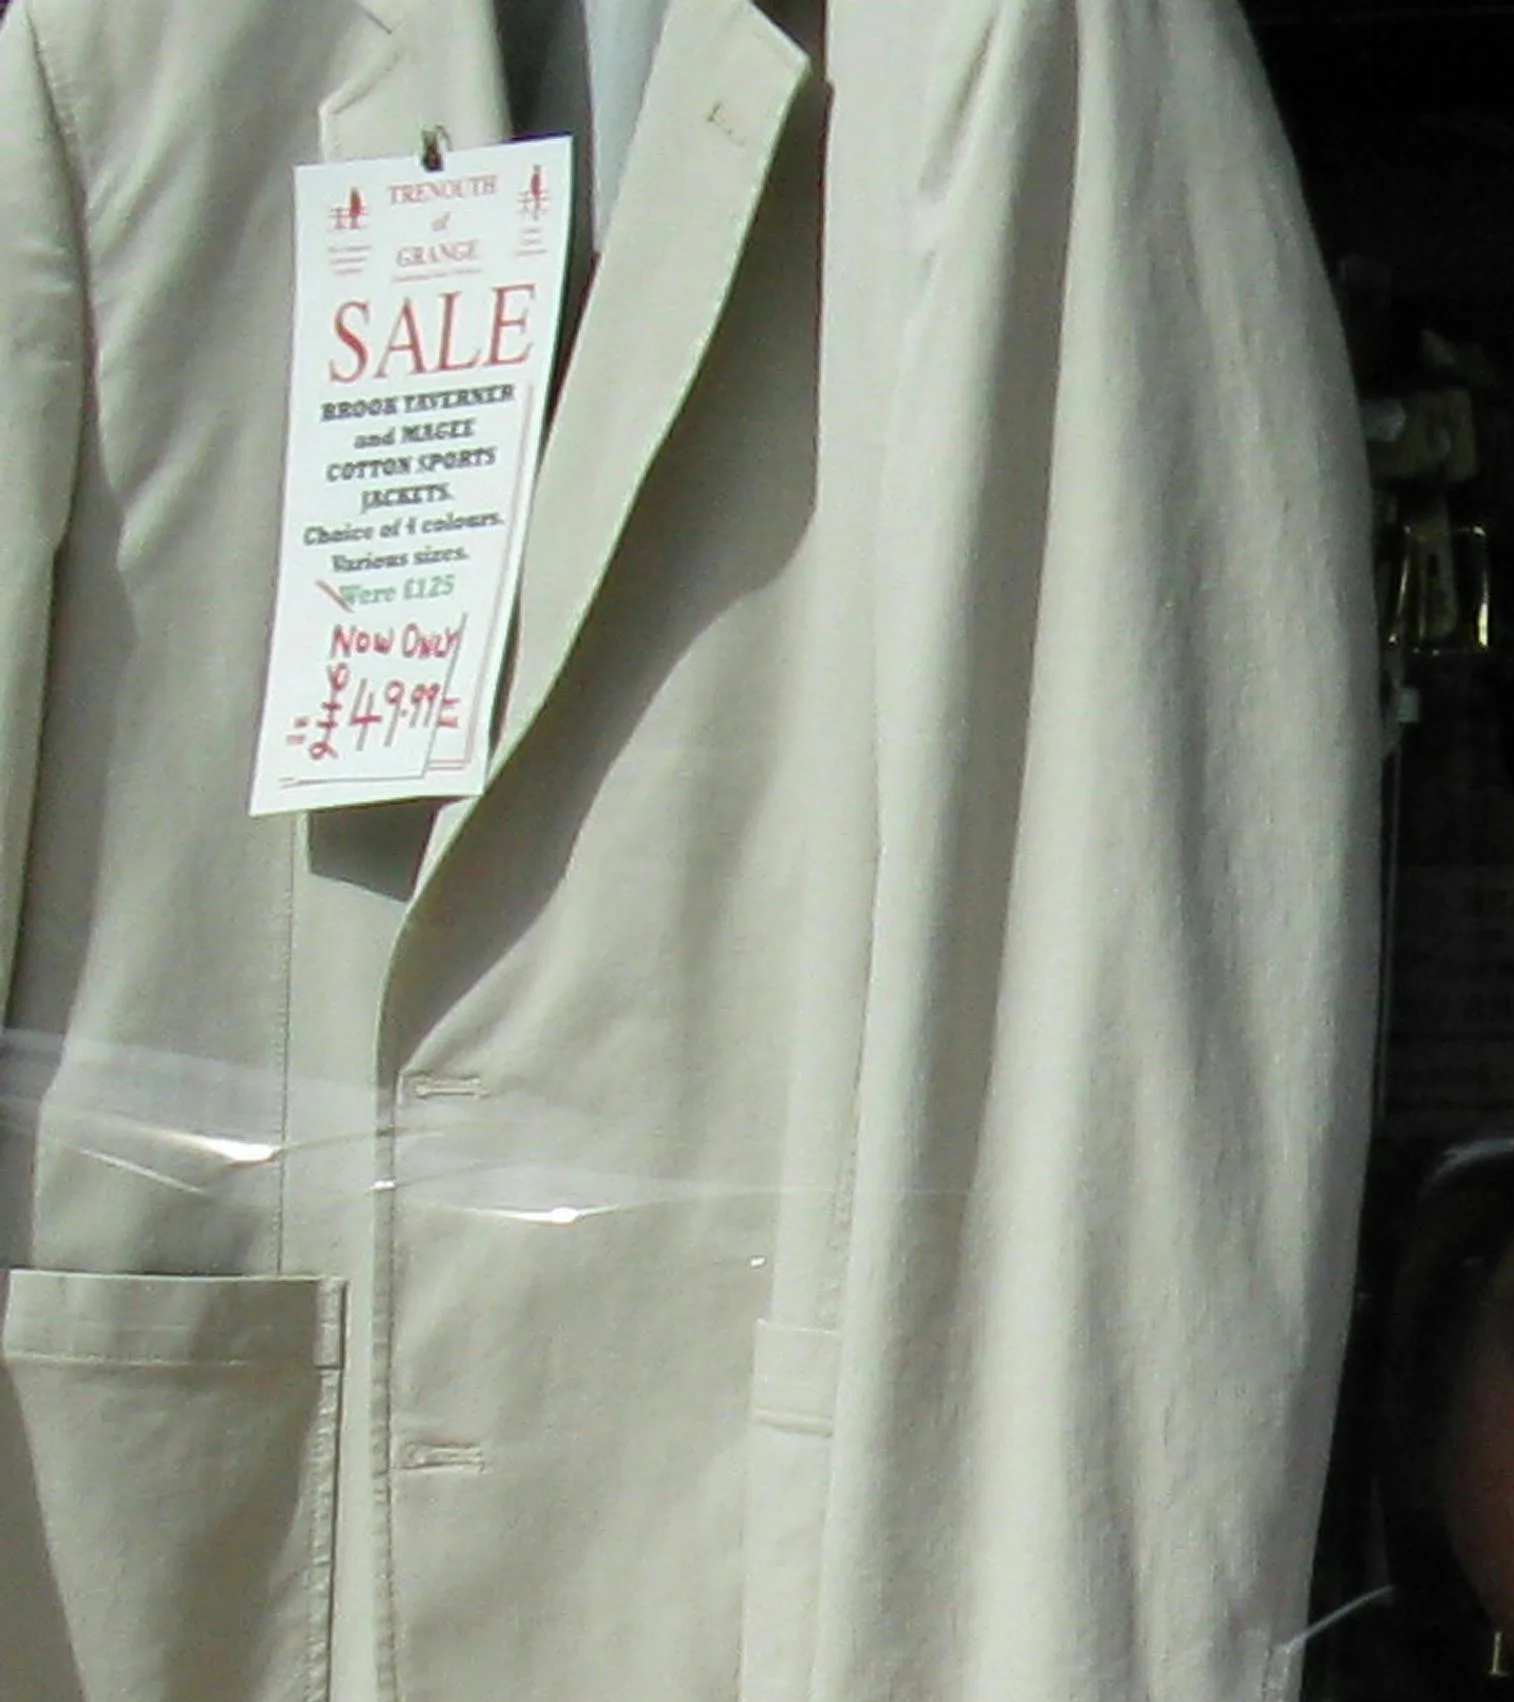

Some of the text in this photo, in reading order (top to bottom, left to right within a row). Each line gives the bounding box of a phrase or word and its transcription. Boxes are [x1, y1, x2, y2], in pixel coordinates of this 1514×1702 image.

[389, 174, 499, 206] TRENOUTH
[430, 211, 451, 232] of
[397, 240, 480, 268] GRANGE
[329, 283, 536, 383] SALE
[321, 391, 397, 422] BROOK
[354, 418, 476, 450] and MAGEE
[326, 447, 497, 482] COTTON SPORTS
[303, 520, 373, 547] Choice
[380, 515, 400, 539] of
[331, 549, 408, 574] Various
[339, 574, 455, 606] Were £125
